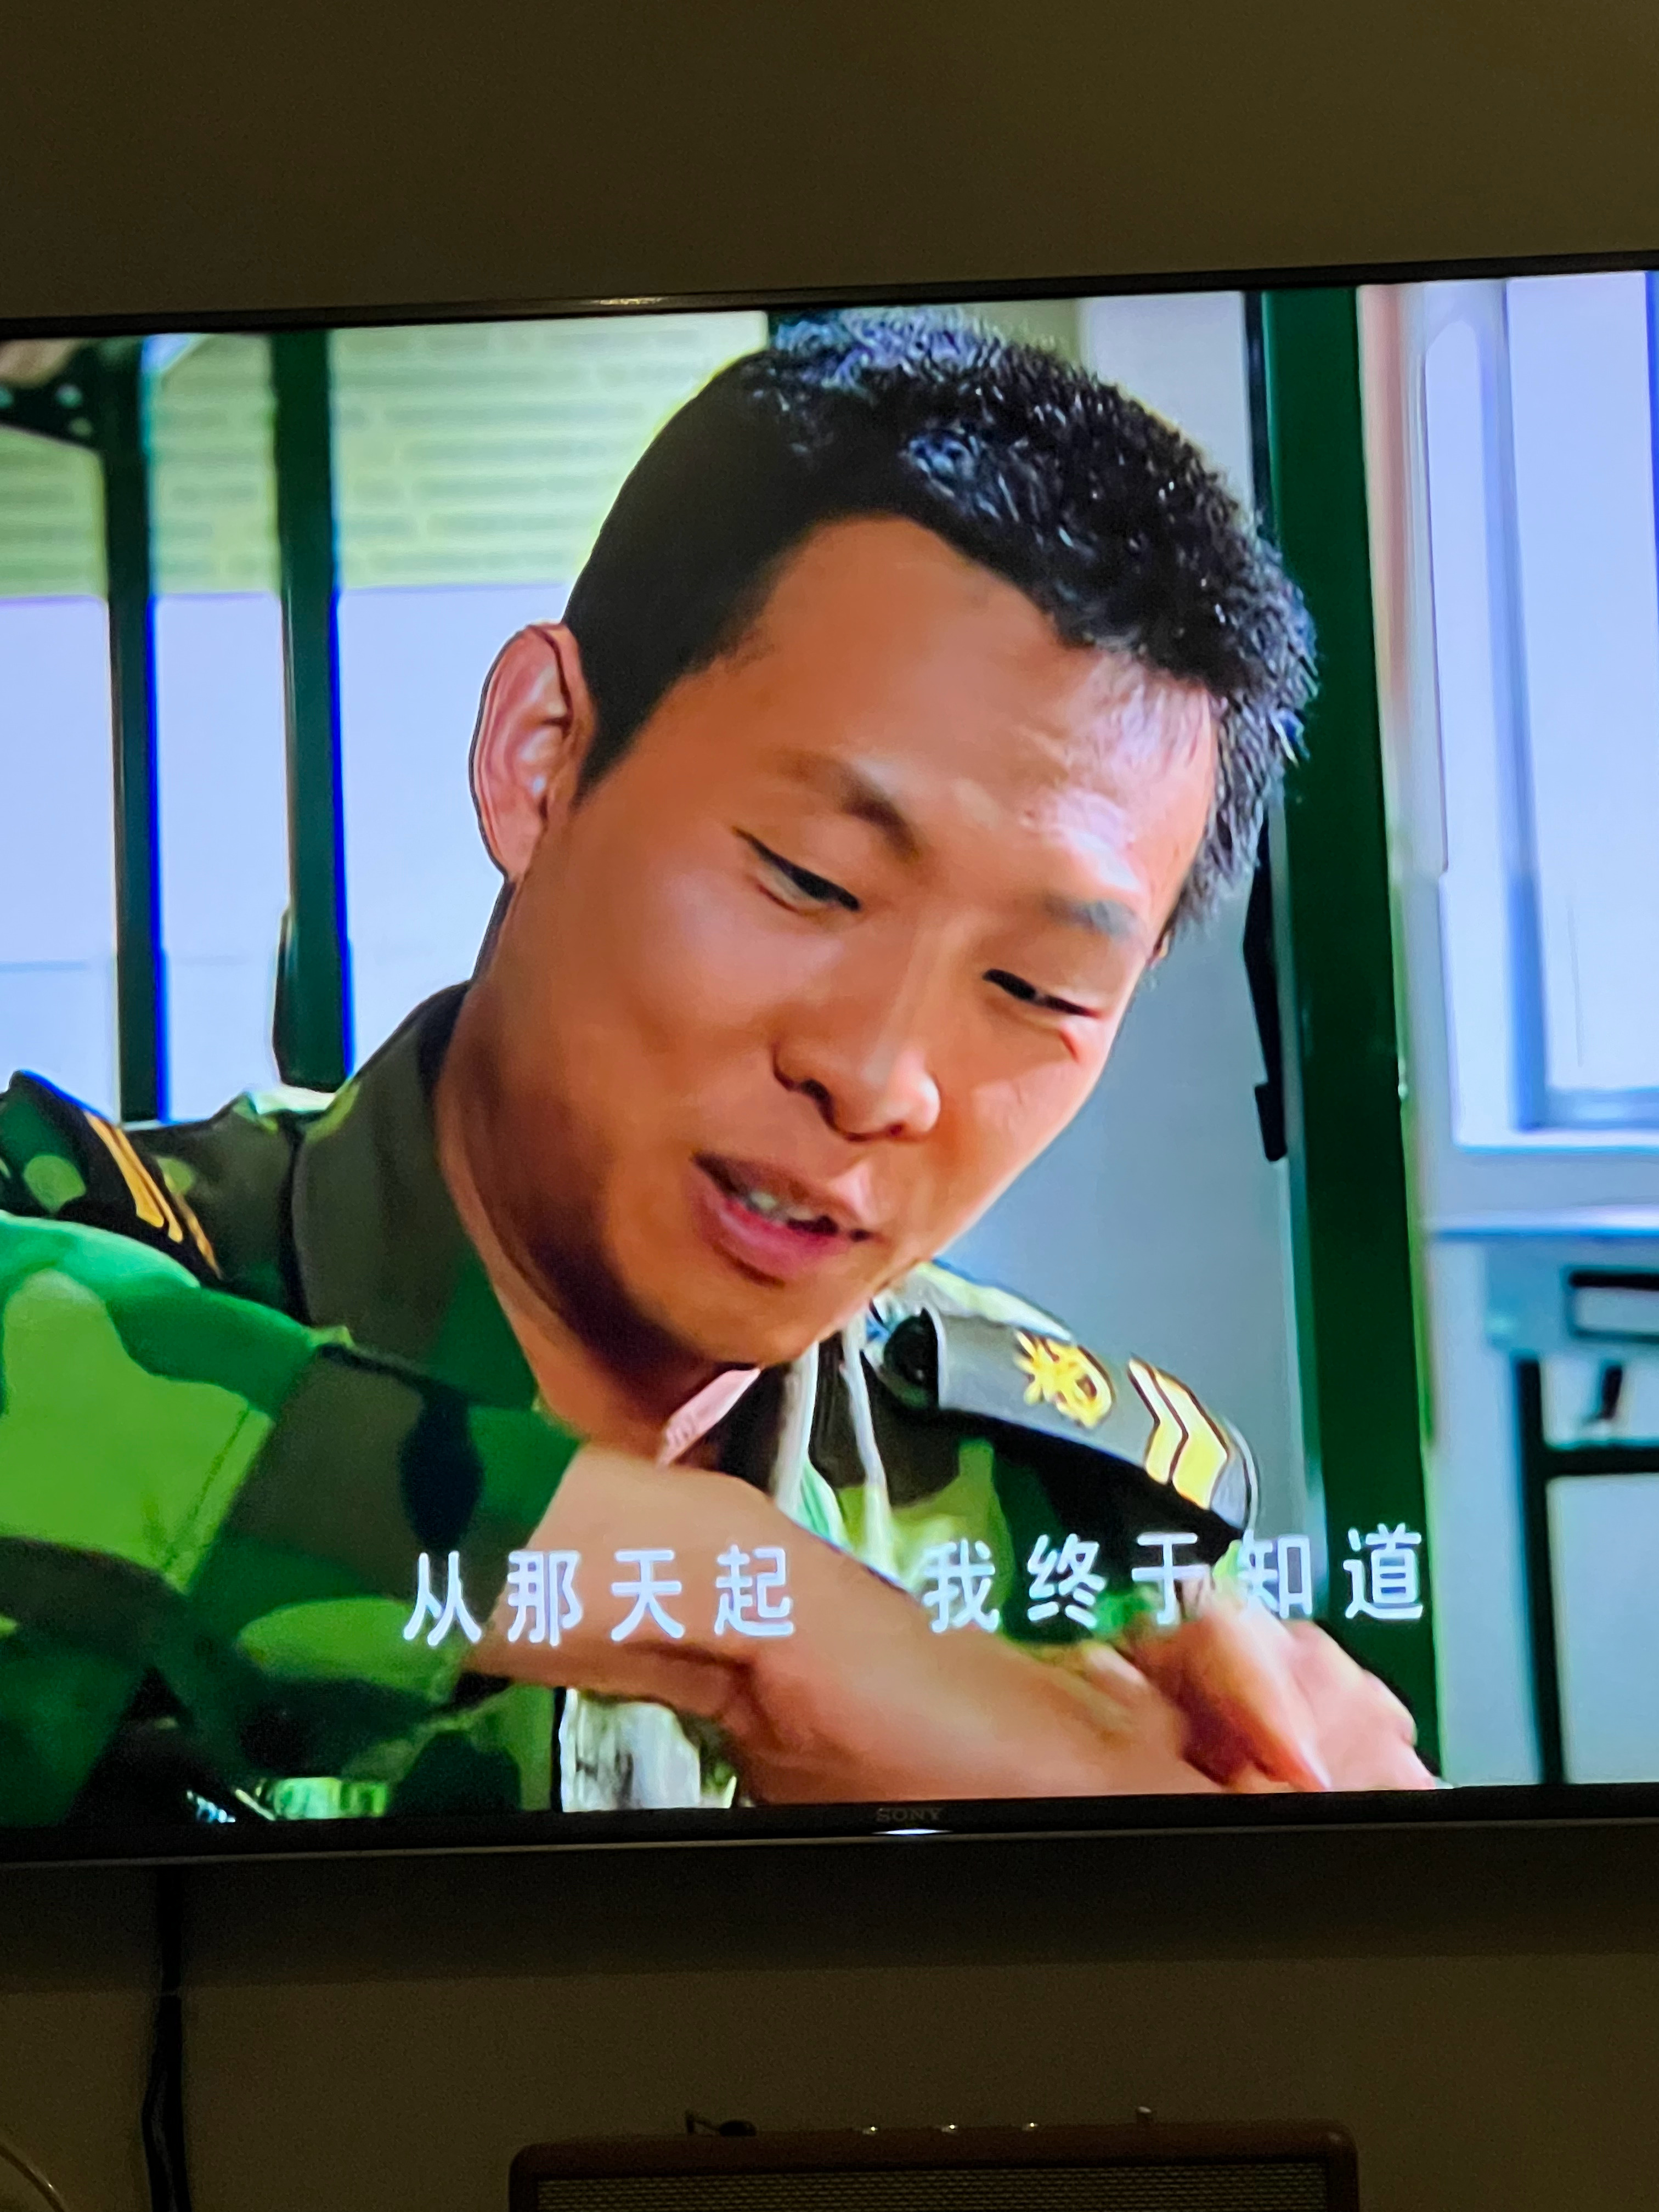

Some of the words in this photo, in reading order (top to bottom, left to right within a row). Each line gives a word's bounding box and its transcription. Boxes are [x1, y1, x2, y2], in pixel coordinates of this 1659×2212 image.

[403, 1544, 794, 1646] 从那天起
[922, 1522, 1424, 1634] 我终于知道
[877, 1807, 943, 1822] SONY
